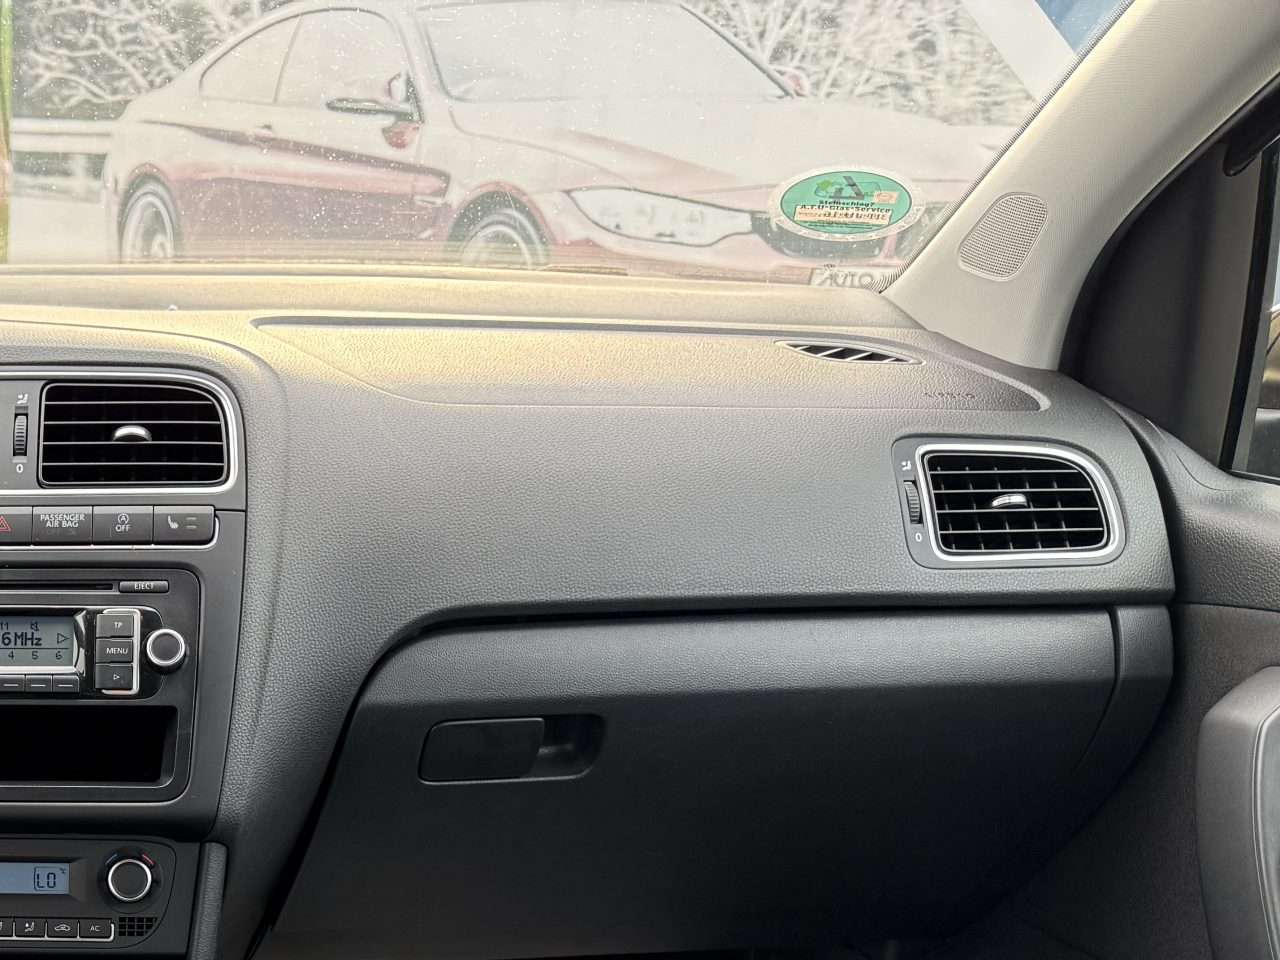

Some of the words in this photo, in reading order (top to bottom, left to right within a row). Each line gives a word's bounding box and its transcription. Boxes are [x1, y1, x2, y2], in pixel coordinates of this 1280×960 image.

[46, 520, 60, 528] AIR
[61, 520, 79, 528] BAG
[115, 525, 131, 533] OFF
[134, 582, 155, 590] EJECT
[106, 647, 128, 655] MENU
[8, 651, 15, 660] 4
[31, 651, 39, 660] 5
[55, 651, 63, 660] 6
